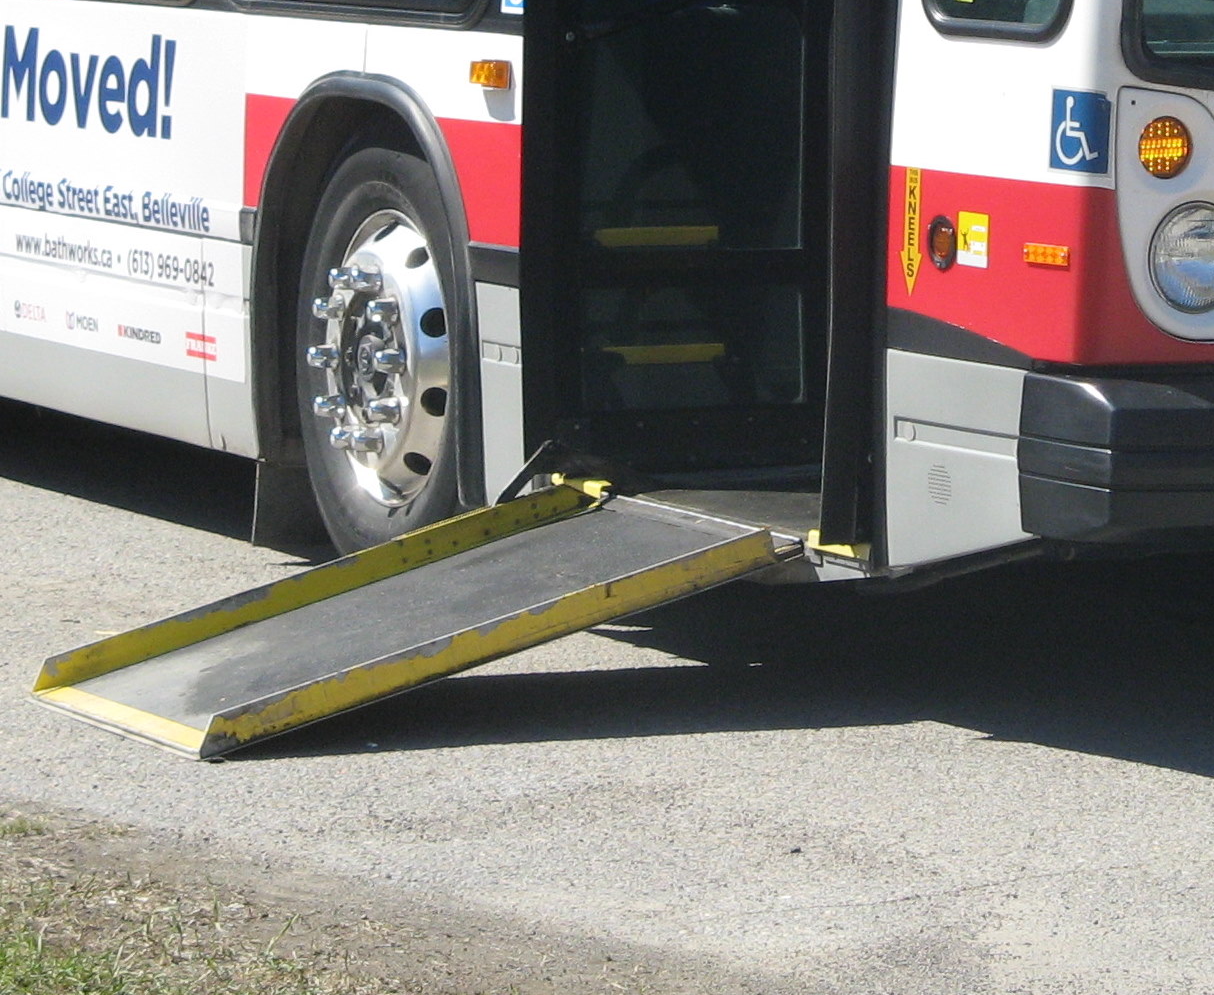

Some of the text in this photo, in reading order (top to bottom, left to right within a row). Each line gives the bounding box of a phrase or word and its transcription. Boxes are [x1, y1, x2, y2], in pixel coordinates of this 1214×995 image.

[1, 24, 177, 140] Moved!
[2, 169, 210, 233] College Street East, Belleville
[15, 232, 215, 287] www.bathworks.ca (613) 969-0842
[906, 185, 918, 278] KNEELS
[76, 314, 99, 332] MOEN
[124, 324, 162, 345] KINDRED
